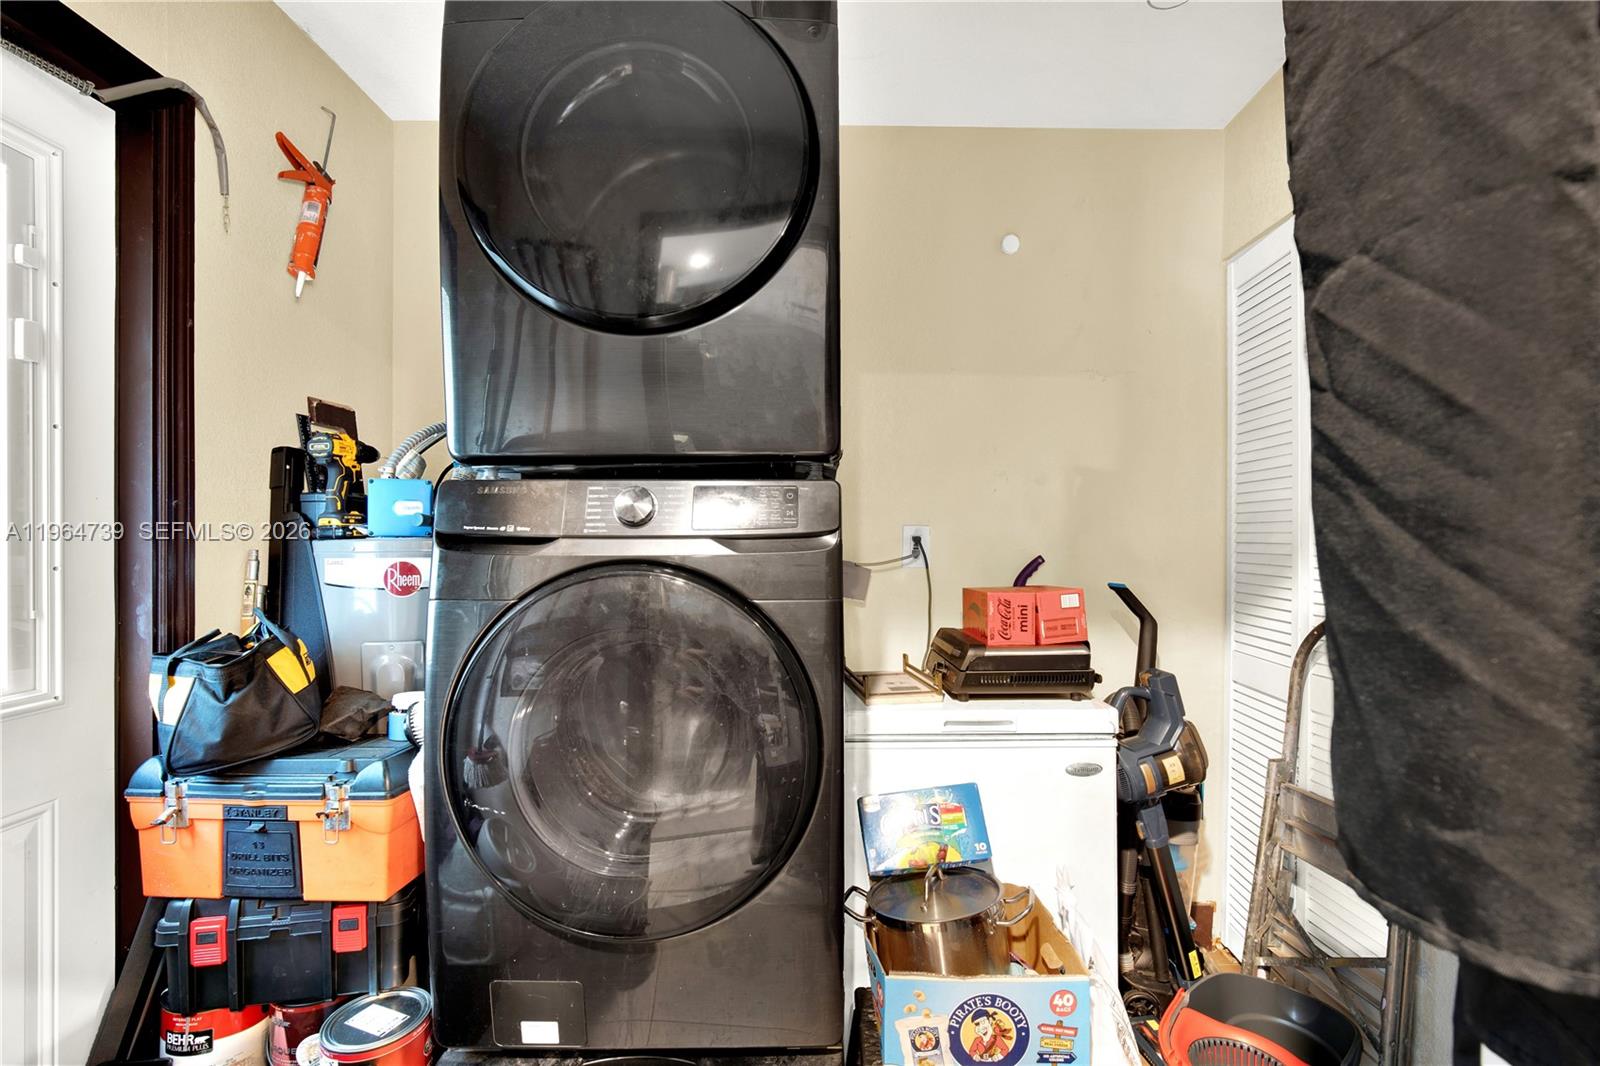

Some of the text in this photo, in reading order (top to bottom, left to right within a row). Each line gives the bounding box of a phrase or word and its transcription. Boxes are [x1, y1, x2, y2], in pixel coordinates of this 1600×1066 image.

[386, 561, 421, 592] Rheem
[1017, 604, 1028, 633] mini
[231, 807, 279, 819] STANLEY
[974, 842, 987, 852] 10
[263, 853, 290, 863] BITS
[229, 867, 292, 877] ORGANIZER
[1052, 993, 1074, 1007] 40
[950, 996, 1028, 1028] PIRATE'S BOOTY
[166, 1032, 195, 1046] BEHR
